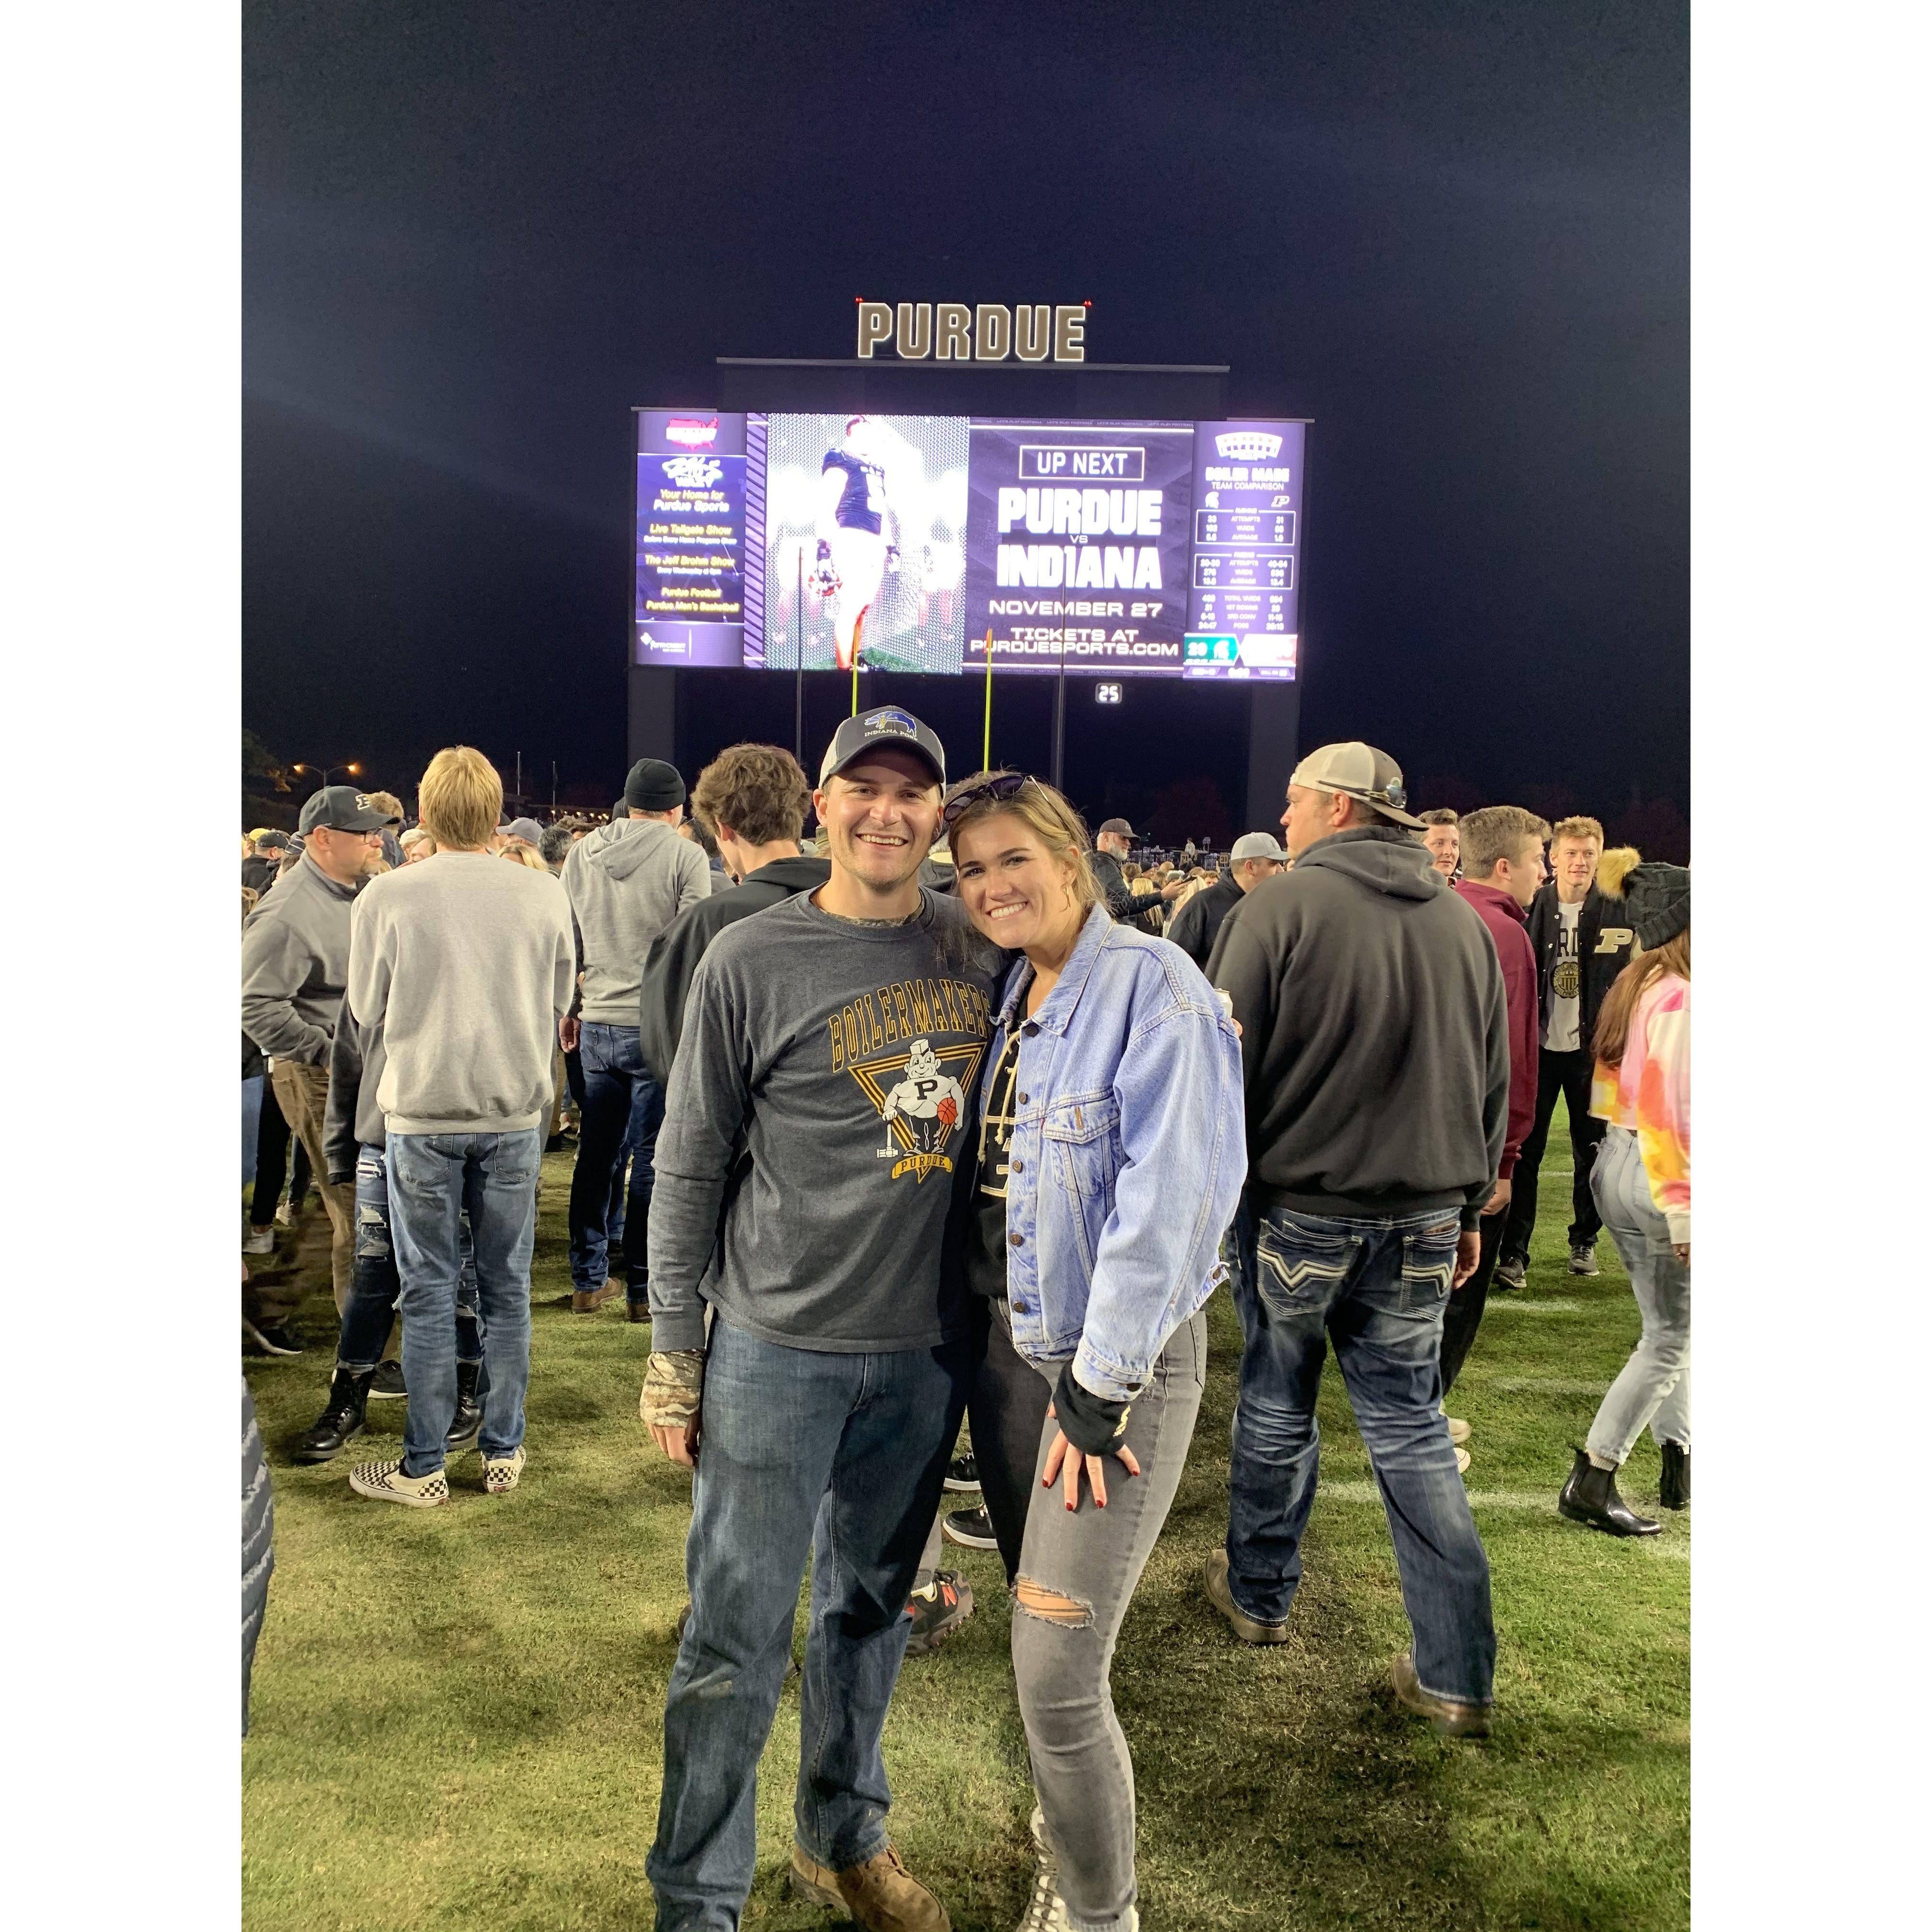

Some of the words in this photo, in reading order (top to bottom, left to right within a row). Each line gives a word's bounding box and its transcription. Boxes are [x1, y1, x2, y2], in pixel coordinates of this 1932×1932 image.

[858, 302, 1086, 362] PURDUE
[1038, 451, 1066, 473] UP
[1073, 453, 1128, 474] NEXT
[1234, 482, 1284, 491] COMPARISON
[660, 489, 681, 499] Your
[682, 490, 709, 499] Home
[711, 490, 724, 500] for
[1271, 495, 1290, 507] P
[654, 499, 692, 511] Purdue
[694, 500, 729, 513] Sports
[998, 488, 1162, 535] PURDUE
[650, 523, 668, 534] Live
[670, 524, 704, 536] Tailgate
[706, 525, 732, 535] Show
[1070, 535, 1088, 544] VS
[645, 554, 661, 565] The
[663, 555, 680, 565] Jeff
[711, 556, 736, 566] Show
[997, 544, 1162, 589] INDIANA
[662, 587, 690, 597] Purdue
[690, 588, 722, 598] Football
[646, 600, 674, 610] Purdue
[675, 601, 698, 611] Men's
[989, 600, 1124, 617] NOVEMBER
[1131, 603, 1162, 618] 27
[1010, 628, 1105, 642] TICKETS
[1111, 629, 1139, 642] AT
[970, 640, 1178, 656] PURDUESPORTS.COM
[1099, 685, 1119, 702] 25
[864, 729, 898, 737] INDIANA
[900, 731, 919, 741] PORK
[1594, 928, 1633, 953] P
[914, 1080, 938, 1100] P
[901, 1156, 945, 1172] PURDUE
[942, 1585, 956, 1607] N
